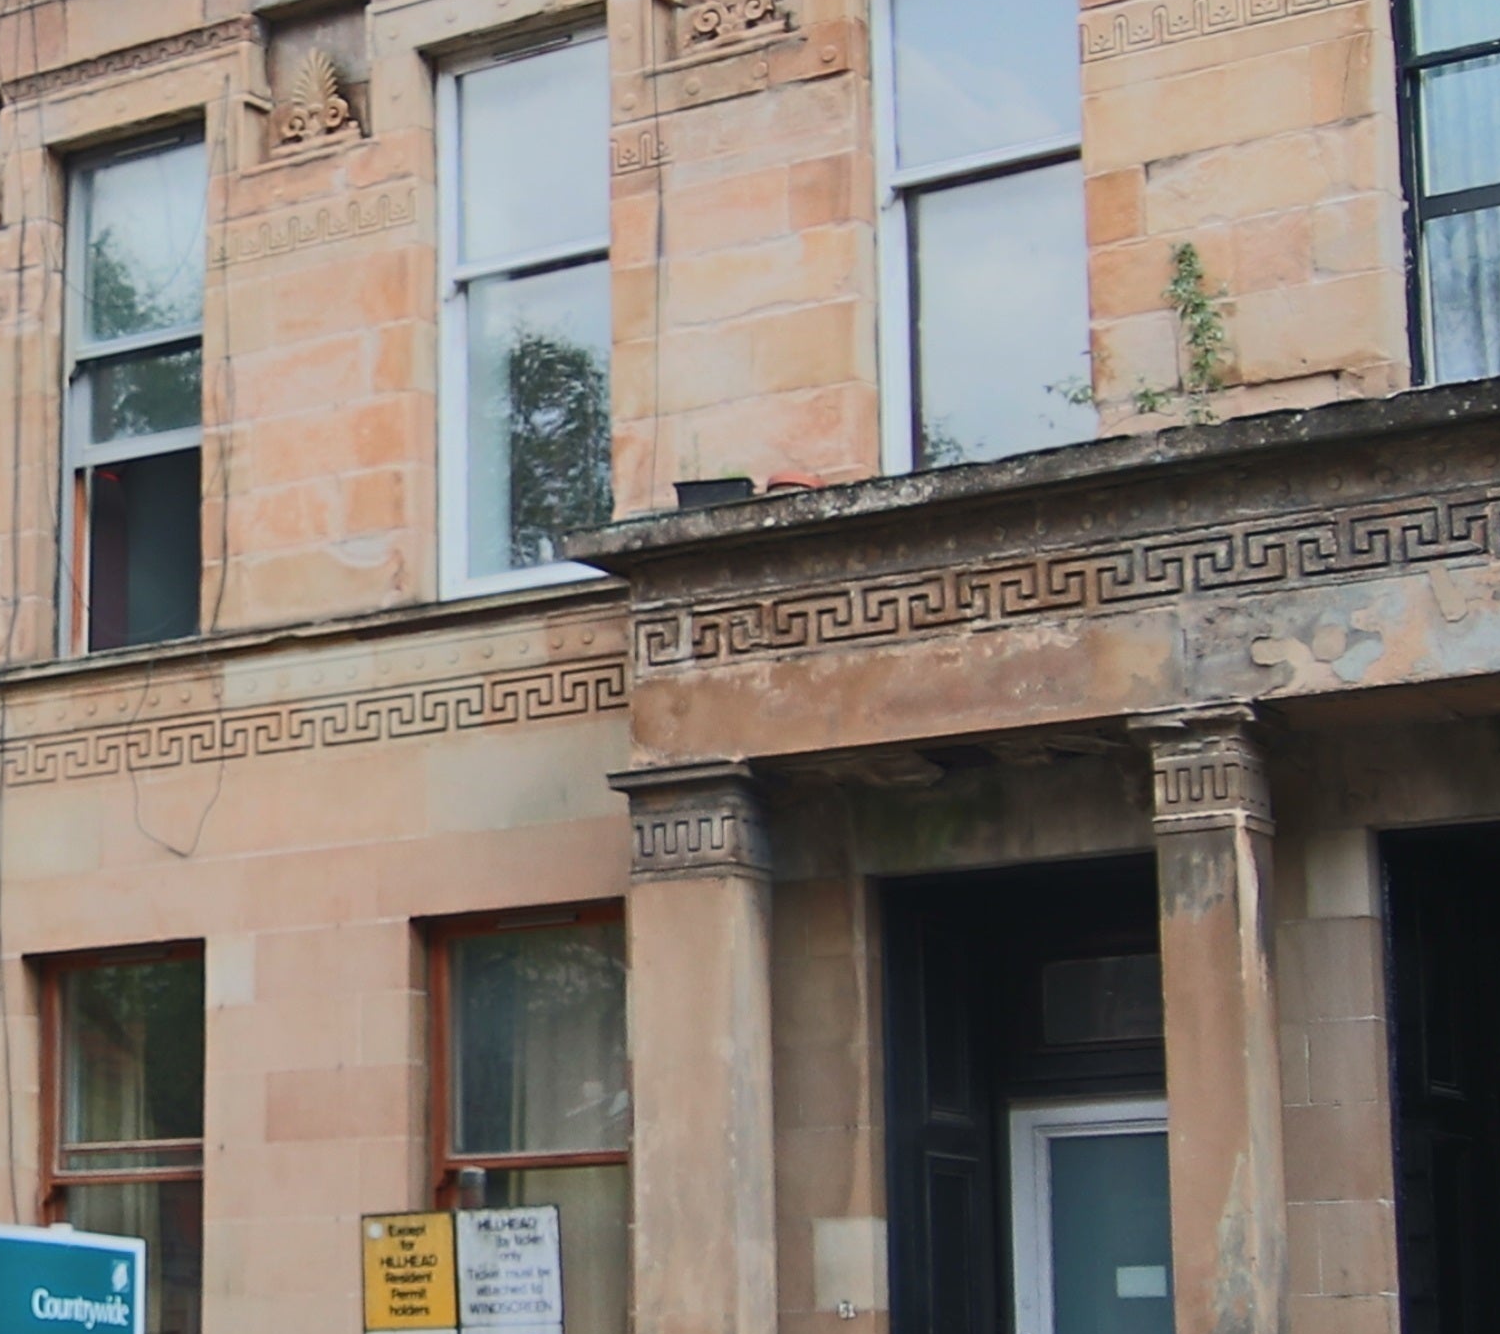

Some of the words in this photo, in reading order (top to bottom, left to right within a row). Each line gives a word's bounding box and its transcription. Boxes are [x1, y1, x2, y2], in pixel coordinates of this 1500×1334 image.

[388, 1224, 427, 1238] Except
[477, 1217, 537, 1232] HILLHEAD
[381, 1254, 438, 1268] HILLHEAD
[385, 1272, 433, 1284] Resident
[391, 1288, 428, 1300] Permit
[31, 1287, 130, 1330] Countrywide
[389, 1305, 431, 1317] holders
[469, 1300, 553, 1316] WINDSCREEN
